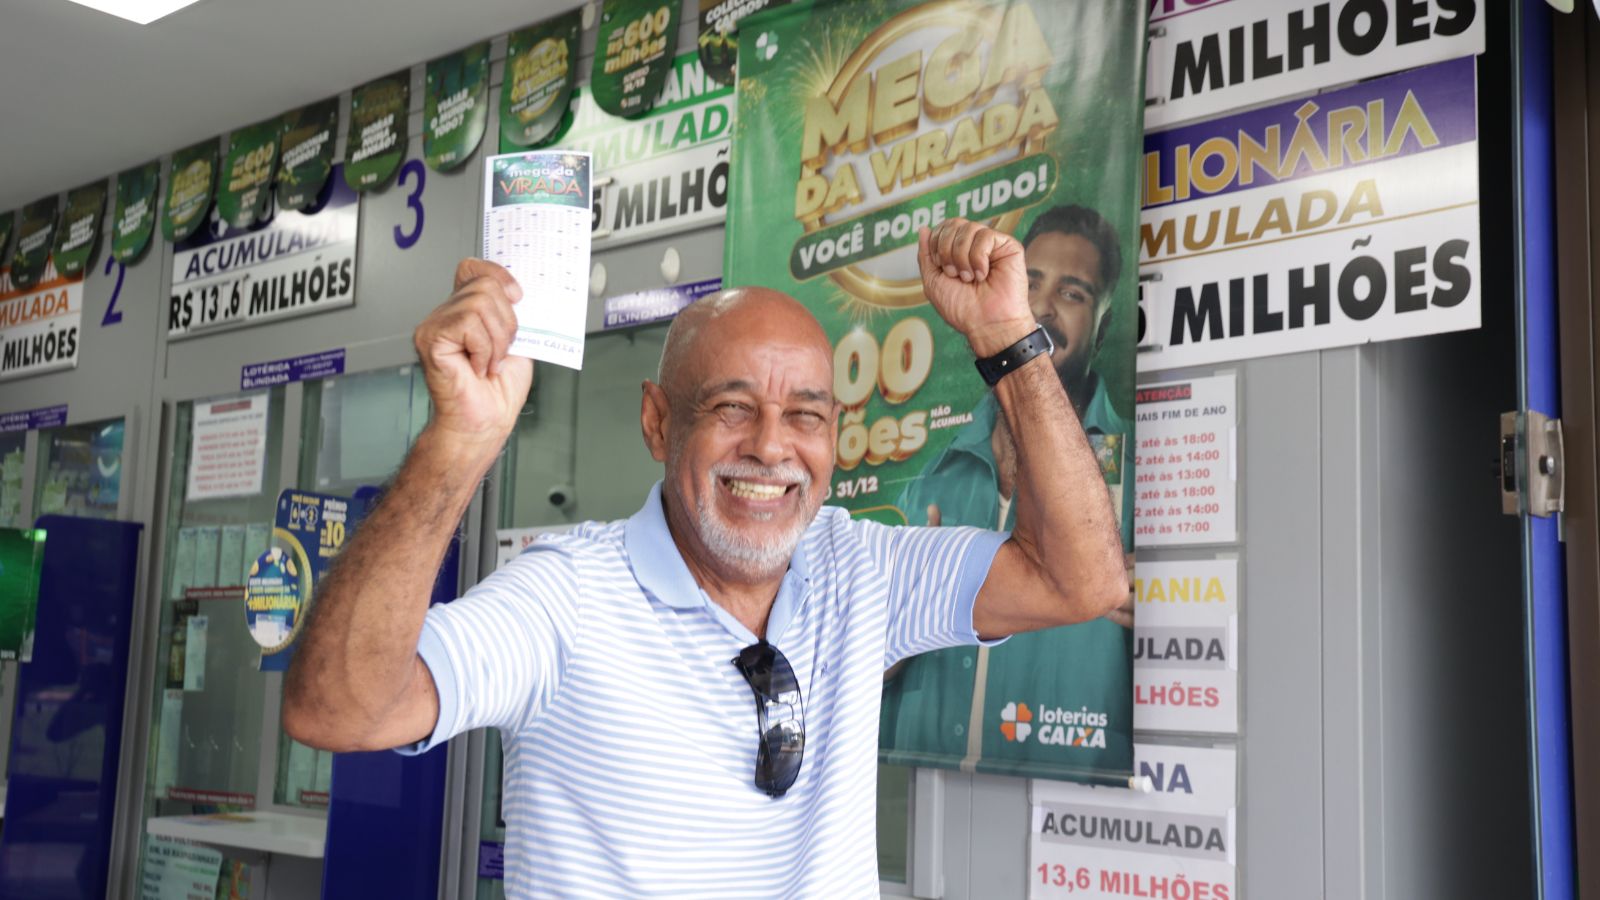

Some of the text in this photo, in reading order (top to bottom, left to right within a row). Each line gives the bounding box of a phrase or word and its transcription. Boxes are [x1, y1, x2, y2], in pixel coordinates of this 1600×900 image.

[624, 6, 670, 47] 600
[801, 1, 1054, 163] MEGA
[794, 83, 1059, 222] DA VIRADA
[509, 165, 575, 178] mega da
[500, 176, 584, 198] VIRADA
[393, 160, 427, 249] 3
[799, 164, 1048, 270] VOCÊ PODE TUDO!
[185, 219, 341, 280] ACUMULADA
[101, 255, 126, 328] 2
[169, 289, 192, 331] R$
[249, 255, 352, 319] MILHÕES
[1169, 235, 1473, 347] MILHÕES
[607, 306, 680, 325] BLINDADA
[2, 321, 77, 371] MILHÕES
[243, 373, 290, 388] BLINDADA
[930, 413, 973, 430] ACUMULA
[931, 405, 951, 419] NÃO
[1162, 409, 1181, 421] FIM
[1185, 407, 1199, 419] DE
[1203, 405, 1227, 417] ANO
[1142, 432, 1216, 449] até às 18:00
[1146, 454, 1164, 466] até
[1168, 452, 1182, 464] às
[1186, 450, 1220, 462] 14:00
[1137, 468, 1211, 483] até às 13:00
[836, 476, 879, 499] 31/12
[1141, 485, 1216, 500] até às 18:00
[1145, 506, 1164, 517] até
[1168, 505, 1182, 516] às
[1186, 503, 1220, 515] 14:00
[326, 520, 345, 547] 10
[1136, 521, 1210, 535] até às 17:00
[1039, 704, 1108, 727] loterias
[1038, 725, 1107, 749] CAIXA
[1042, 812, 1226, 853] ACUMULADA
[1037, 863, 1230, 900] 13,6 MILHÕES
